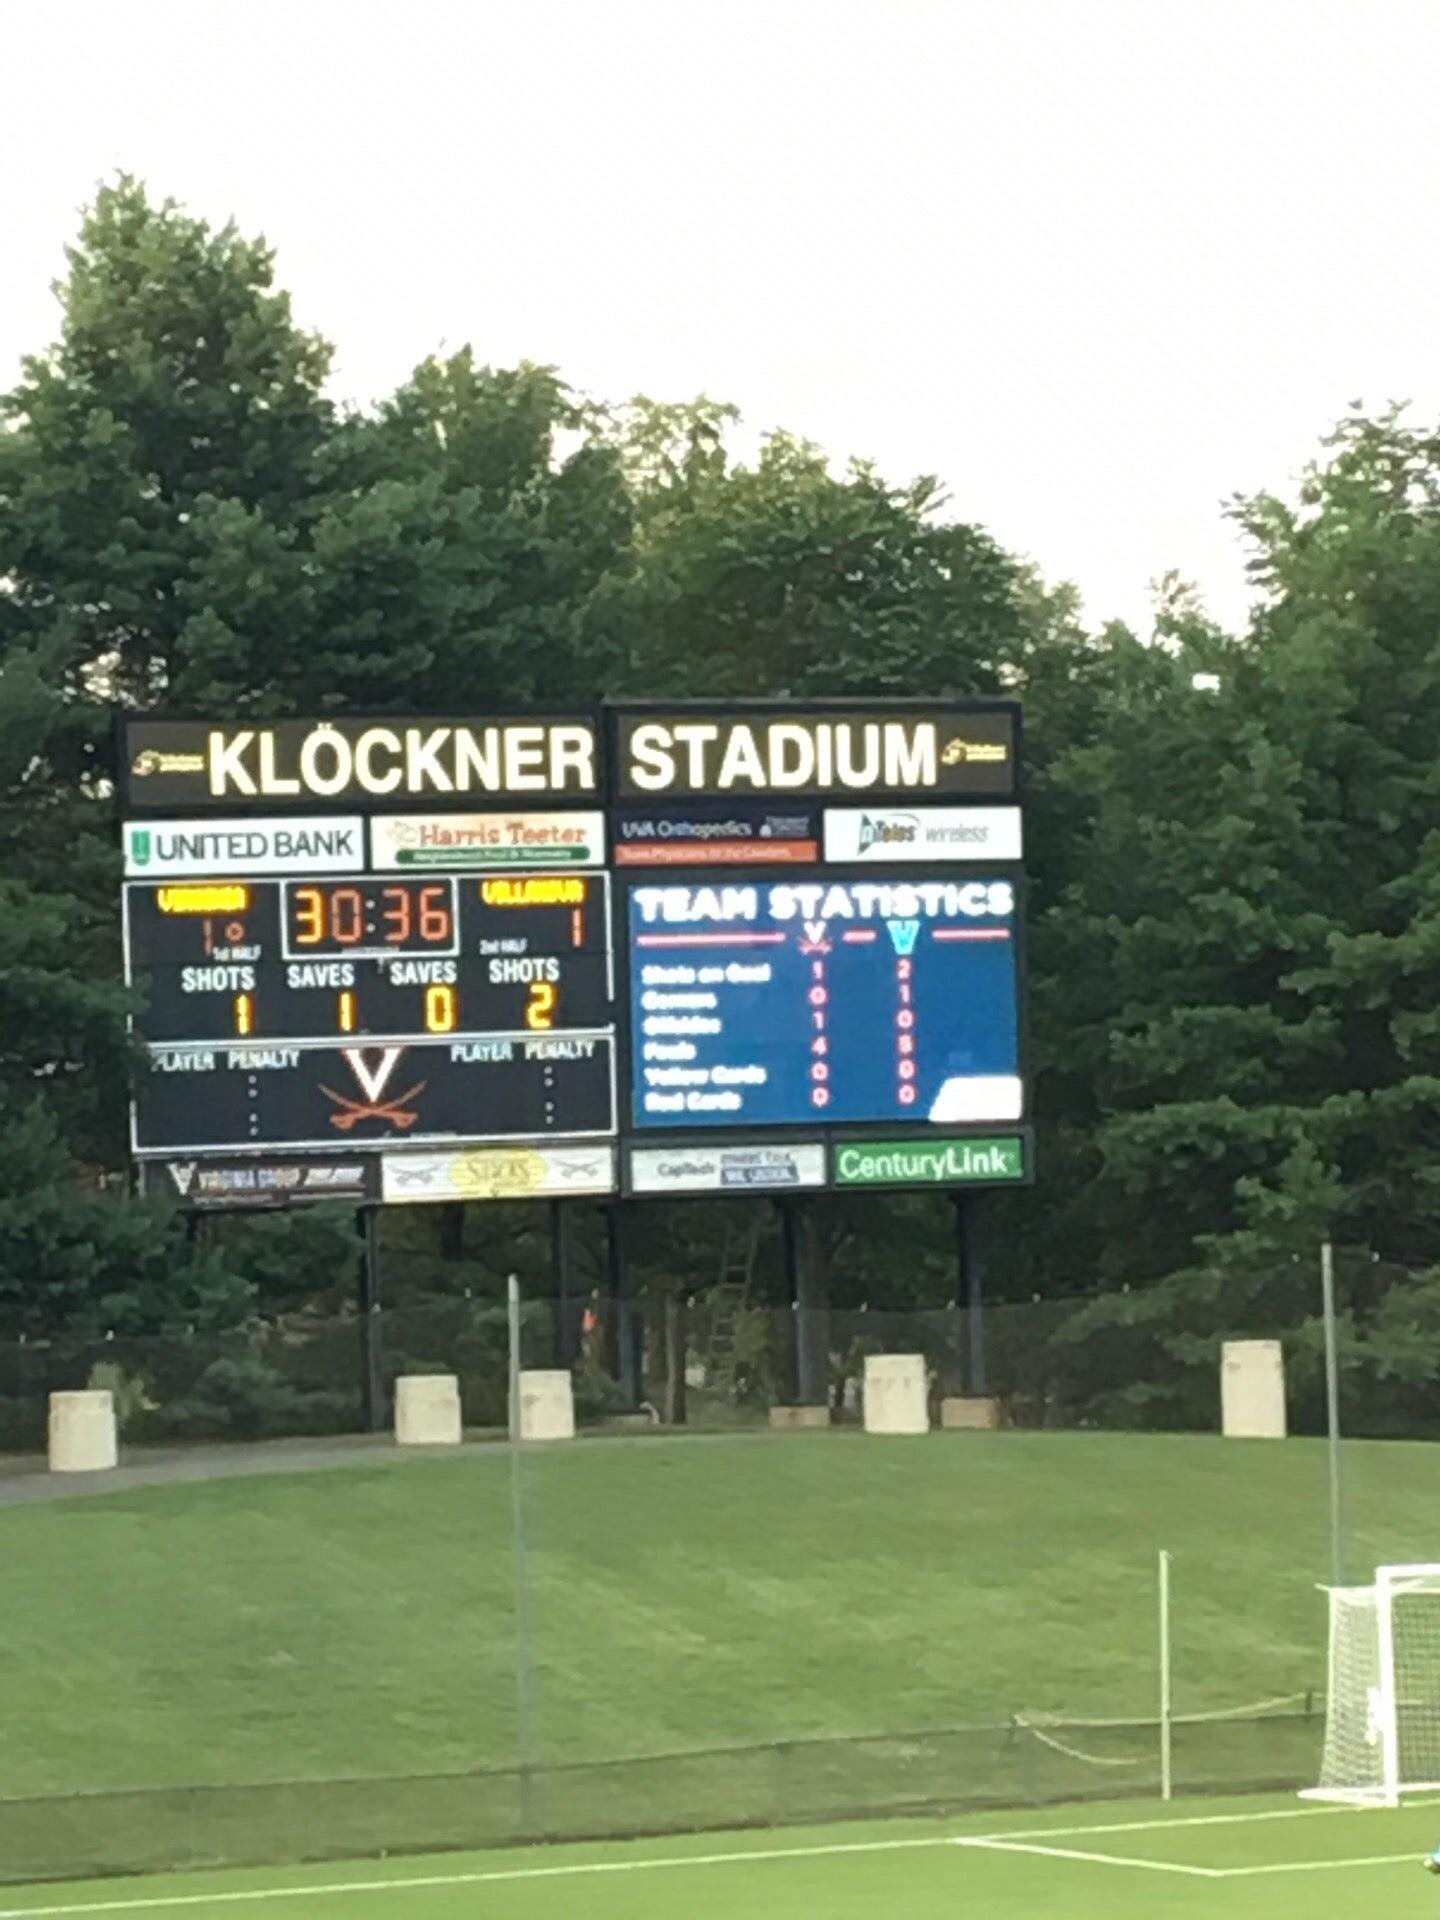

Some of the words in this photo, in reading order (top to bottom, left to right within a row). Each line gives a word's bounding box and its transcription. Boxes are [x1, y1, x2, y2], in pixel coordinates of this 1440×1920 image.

[208, 723, 596, 796] KLÖCKNER
[629, 723, 938, 791] STADIUM
[156, 833, 268, 859] UNITED
[274, 830, 354, 857] BANK
[420, 823, 500, 847] Harris
[506, 821, 588, 845] Teeter
[293, 887, 450, 944] 30:36
[634, 886, 757, 922] TEAM
[768, 882, 1014, 918] STATISTICS
[181, 966, 256, 992] SHOTS
[287, 963, 355, 987] SAVES
[390, 960, 458, 984] SAVES
[488, 957, 561, 982] SHOTS
[235, 994, 251, 1035] 1
[340, 993, 353, 1033] 1
[426, 986, 455, 1031] 0
[528, 984, 555, 1028] 2
[227, 1048, 300, 1070] PENALTY
[449, 1043, 515, 1063] PLAYER
[525, 1040, 597, 1060] PENALTY
[837, 1146, 1009, 1180] CenturyLink
